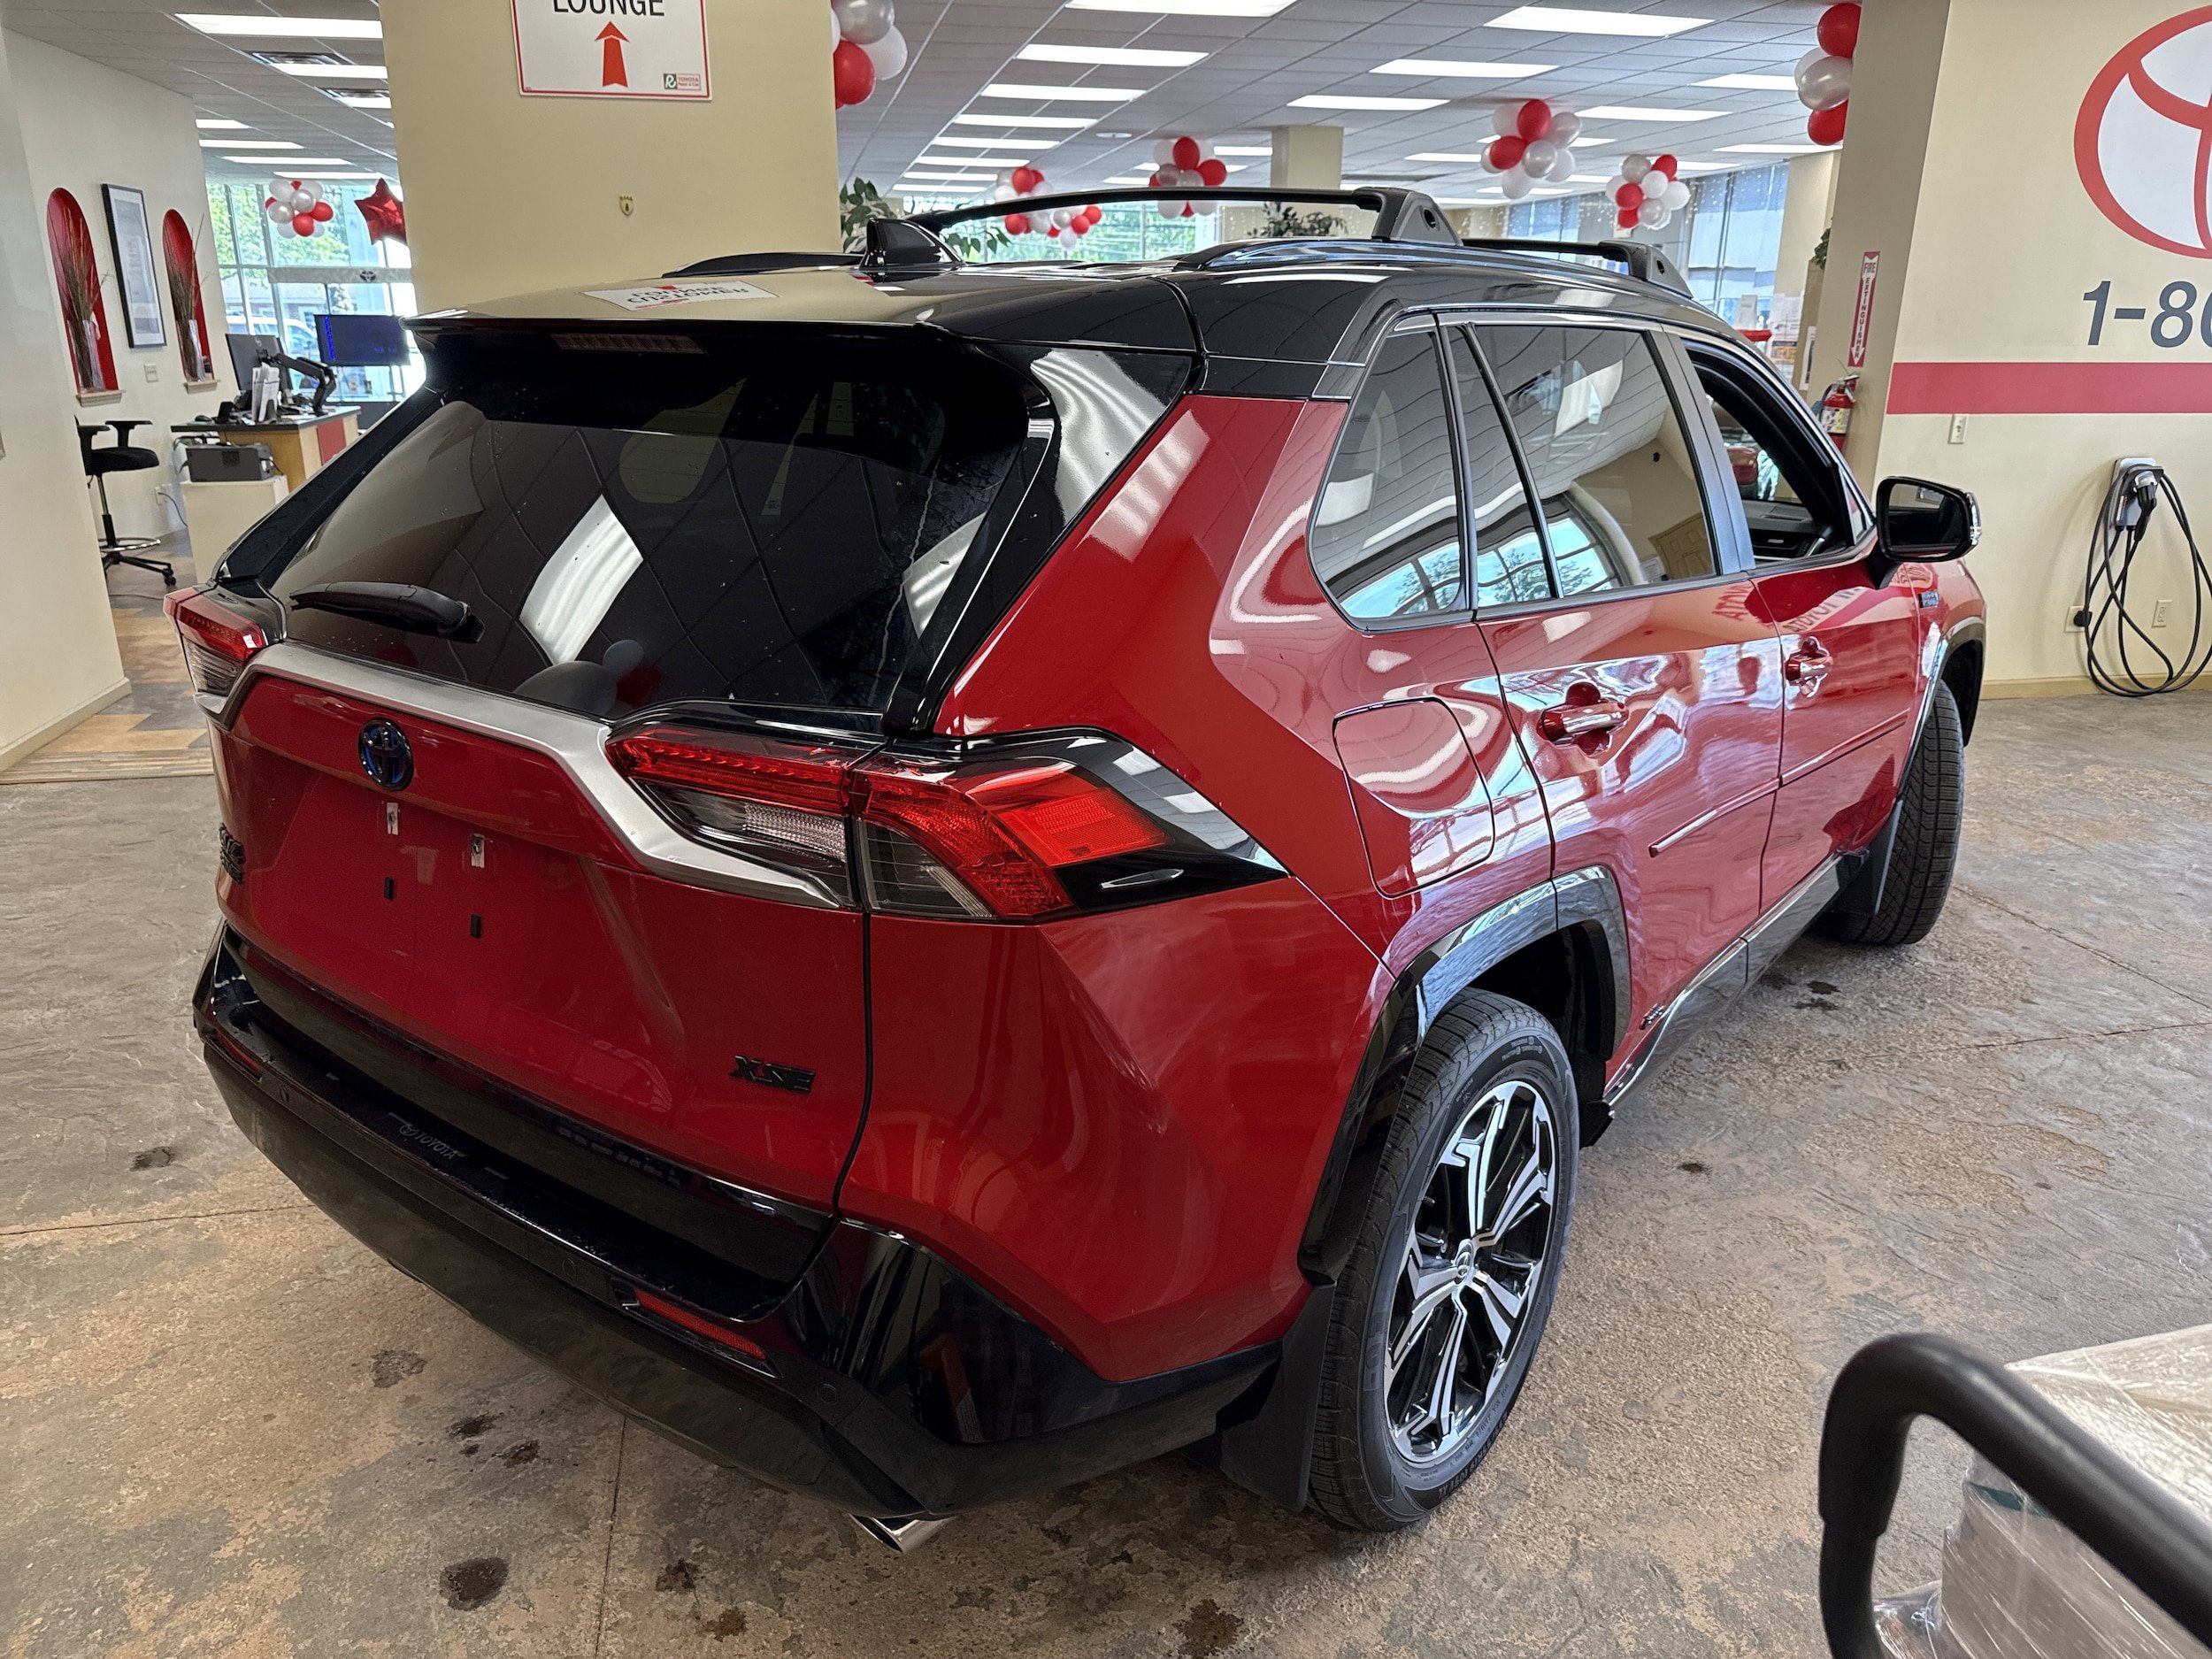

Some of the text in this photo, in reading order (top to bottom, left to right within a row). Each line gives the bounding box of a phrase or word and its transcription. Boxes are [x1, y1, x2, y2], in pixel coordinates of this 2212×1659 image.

[1863, 262, 1876, 273] FIRE
[1855, 277, 1870, 358] EXTINGUISHER
[2083, 280, 2212, 349] 1-8
[728, 1054, 815, 1094] XSE
[413, 1132, 455, 1160] TOYOTA
